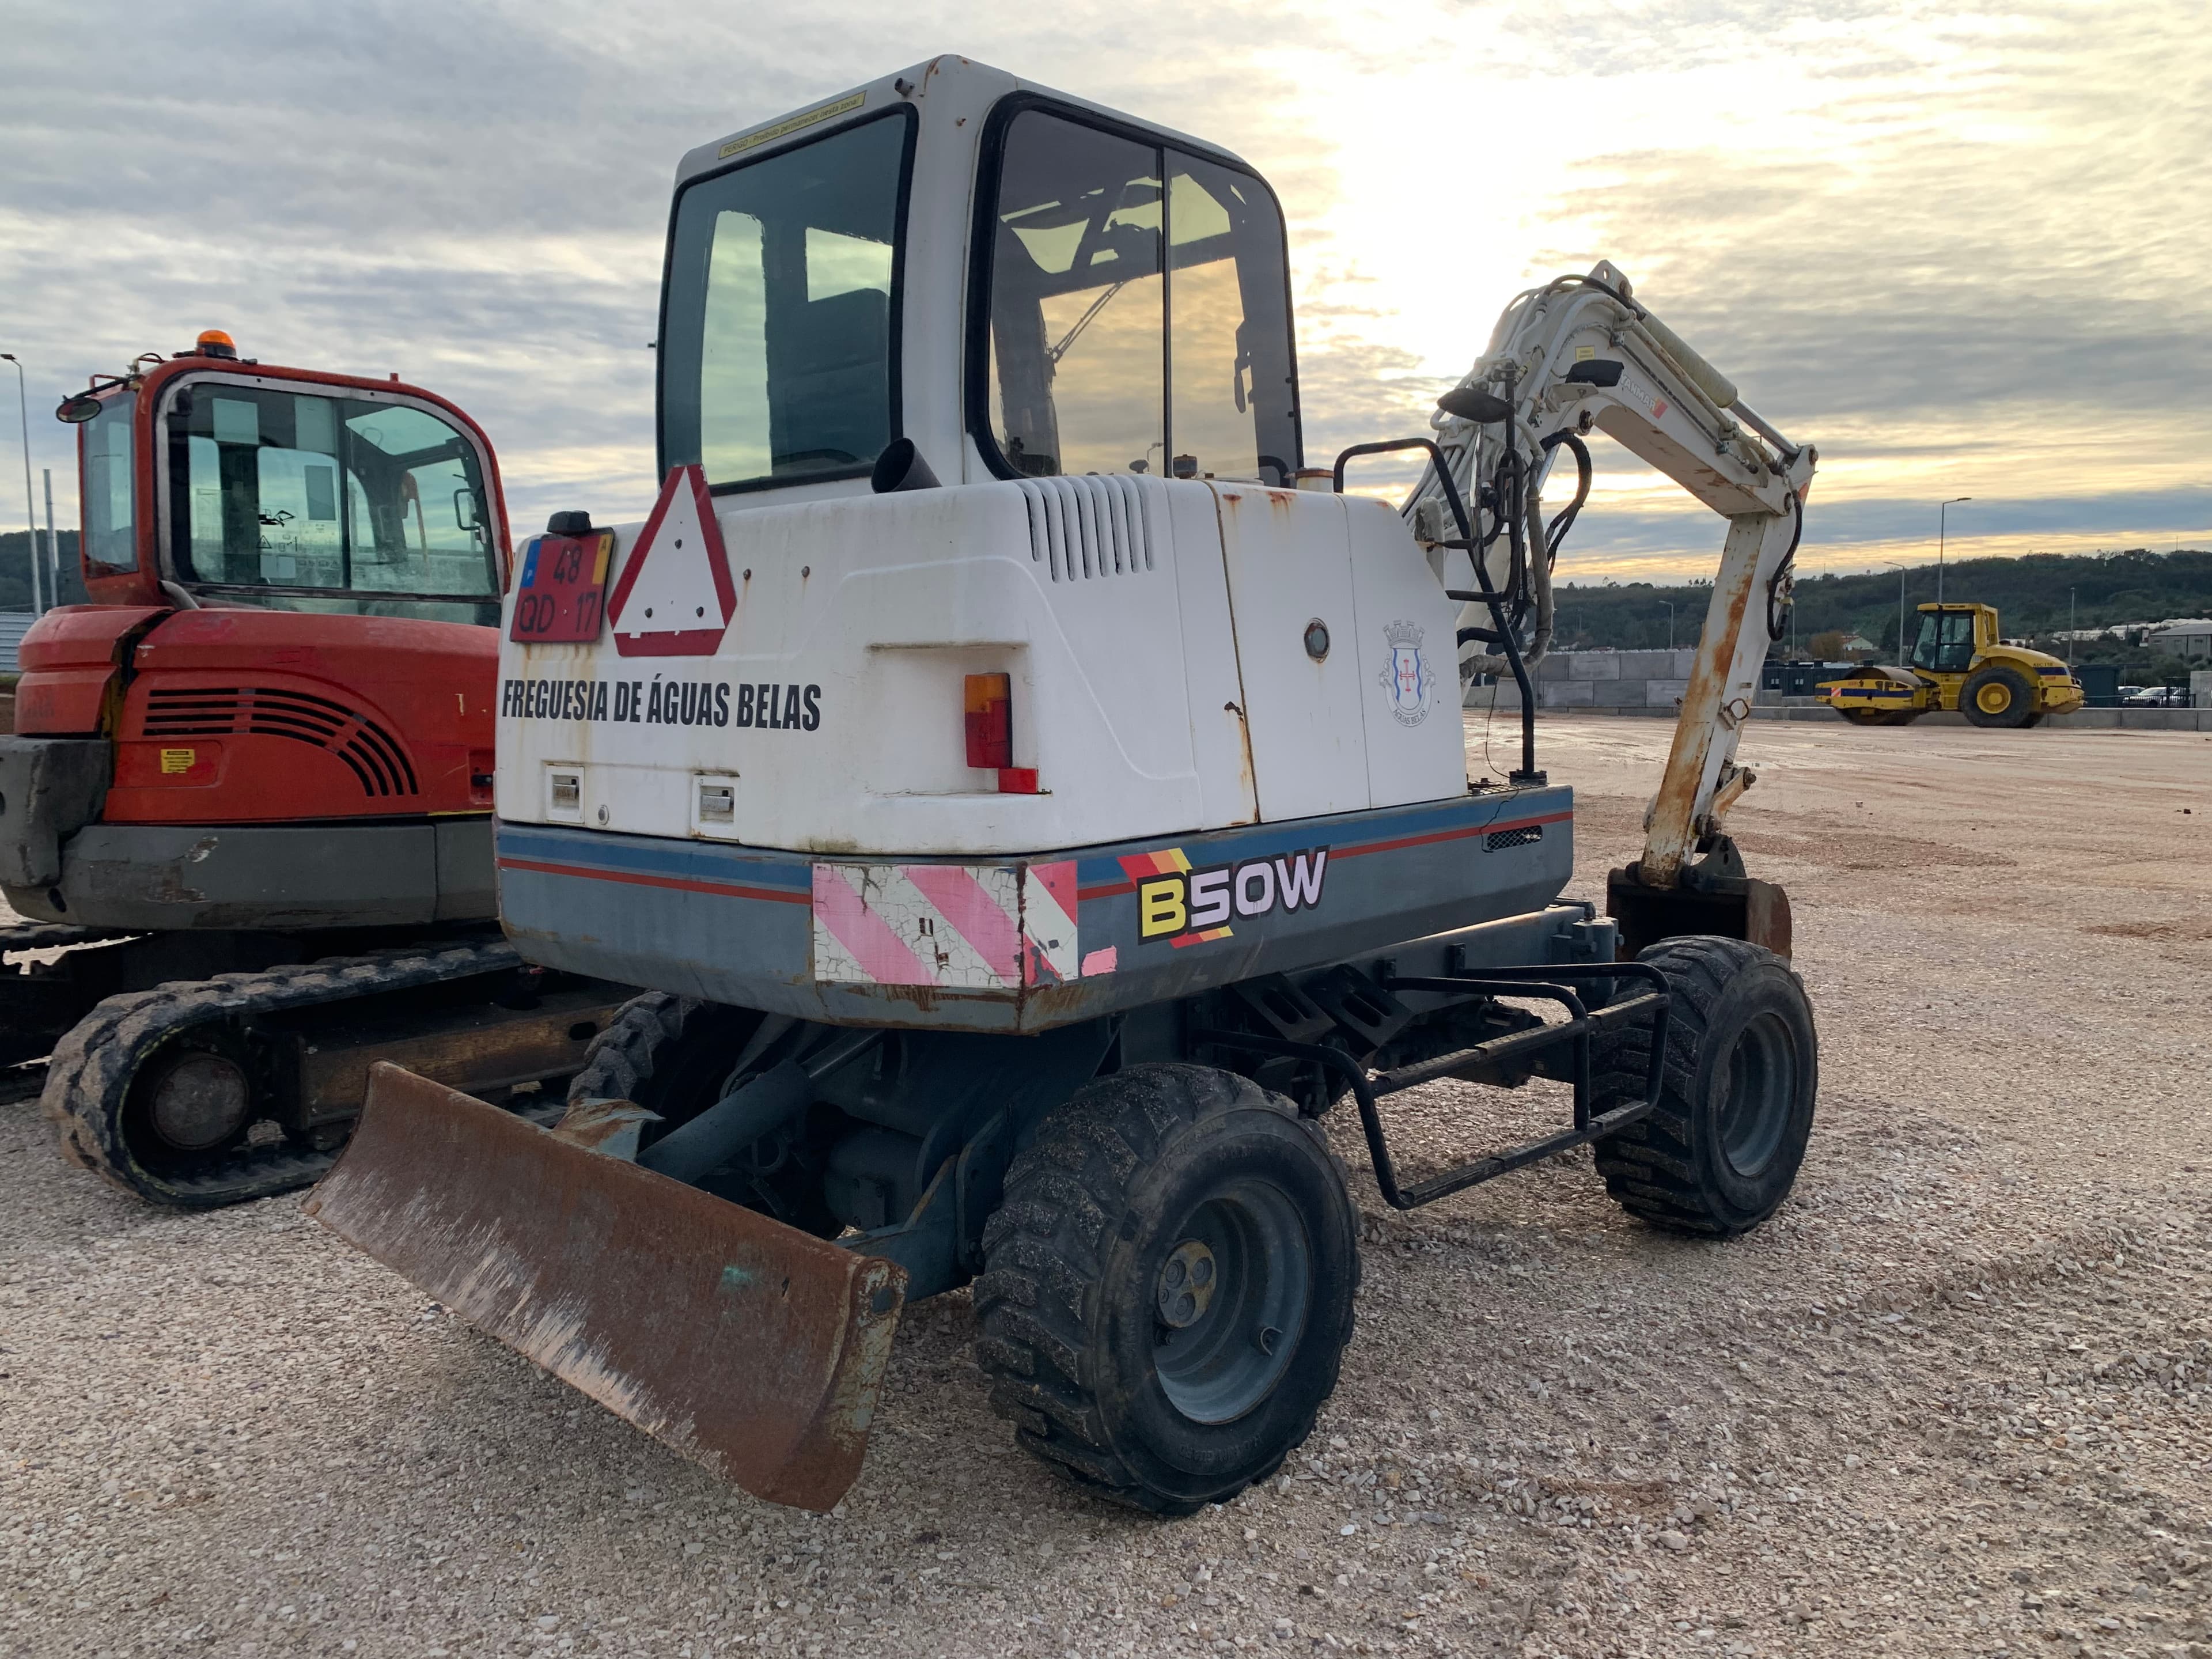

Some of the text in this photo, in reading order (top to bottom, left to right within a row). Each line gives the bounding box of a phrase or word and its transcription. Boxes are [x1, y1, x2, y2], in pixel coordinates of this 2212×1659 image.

[724, 139, 748, 154] PERIGO
[753, 128, 779, 144] Proibido
[780, 112, 819, 134] permanecer
[820, 106, 839, 118] nesta
[1620, 374, 1656, 411] YANMAR
[553, 543, 583, 584] 48
[520, 592, 597, 632] QD 17
[502, 673, 821, 732] FREGUESIA DE ÁGUAS BELAS
[1139, 846, 1329, 941] B50W
